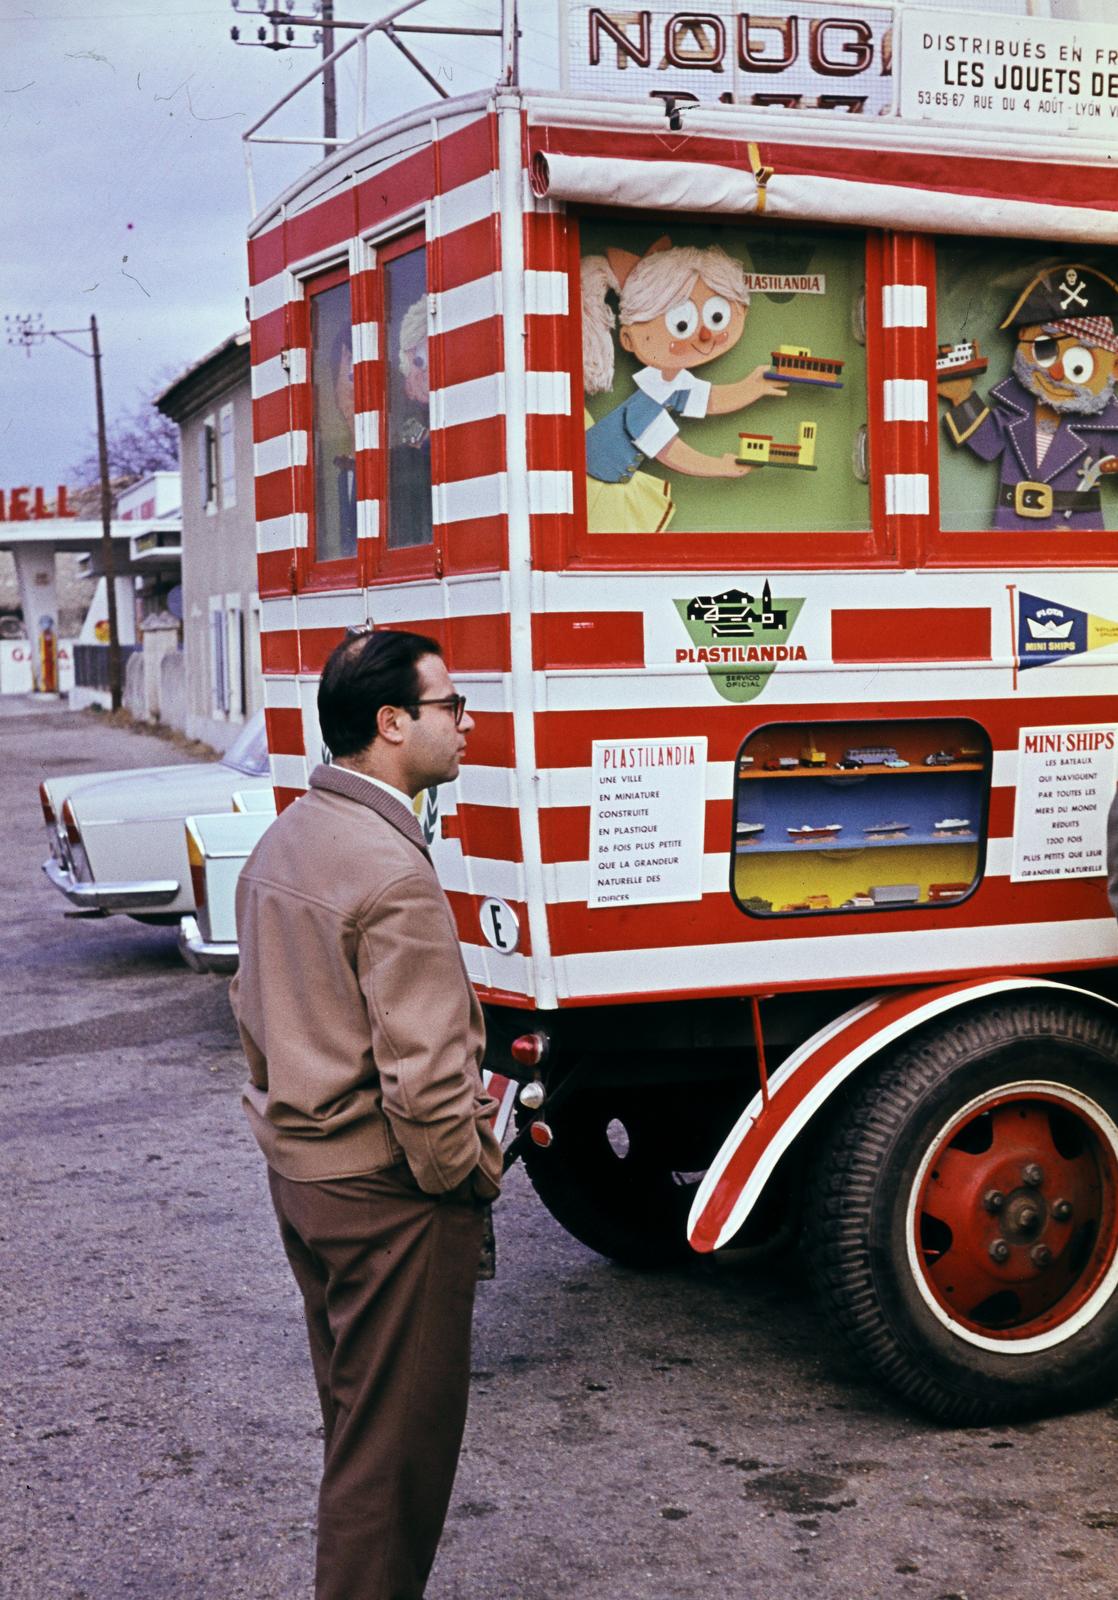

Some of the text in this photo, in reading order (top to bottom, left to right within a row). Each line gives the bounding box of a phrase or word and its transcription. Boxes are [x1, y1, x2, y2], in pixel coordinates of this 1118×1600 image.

[589, 8, 892, 76] NOUG
[1060, 46, 1081, 61] EN
[944, 60, 1118, 98] LES JOUETS DE
[974, 96, 992, 109] RUE
[1003, 98, 1015, 110] DU
[1024, 99, 1030, 110] 4
[0, 484, 80, 520] ELL
[1025, 642, 1076, 650] MINI SHIPS
[676, 646, 807, 663] PLASTILANDIA
[604, 746, 695, 768] PLASTILANDIA
[600, 776, 616, 784] UNE
[1056, 773, 1097, 781] NAVIGUENT
[615, 791, 660, 800] MINIATURE
[599, 809, 648, 818] CONSTRUITE
[615, 825, 657, 834] PLASTIQUE
[636, 842, 654, 850] PLUS
[660, 840, 681, 848] PETITE
[599, 862, 615, 870] QUE
[635, 857, 678, 867] GRANDEUR
[1065, 865, 1102, 874] NATURELLE
[598, 875, 660, 886] NATURELLE DES
[490, 904, 507, 948] E
